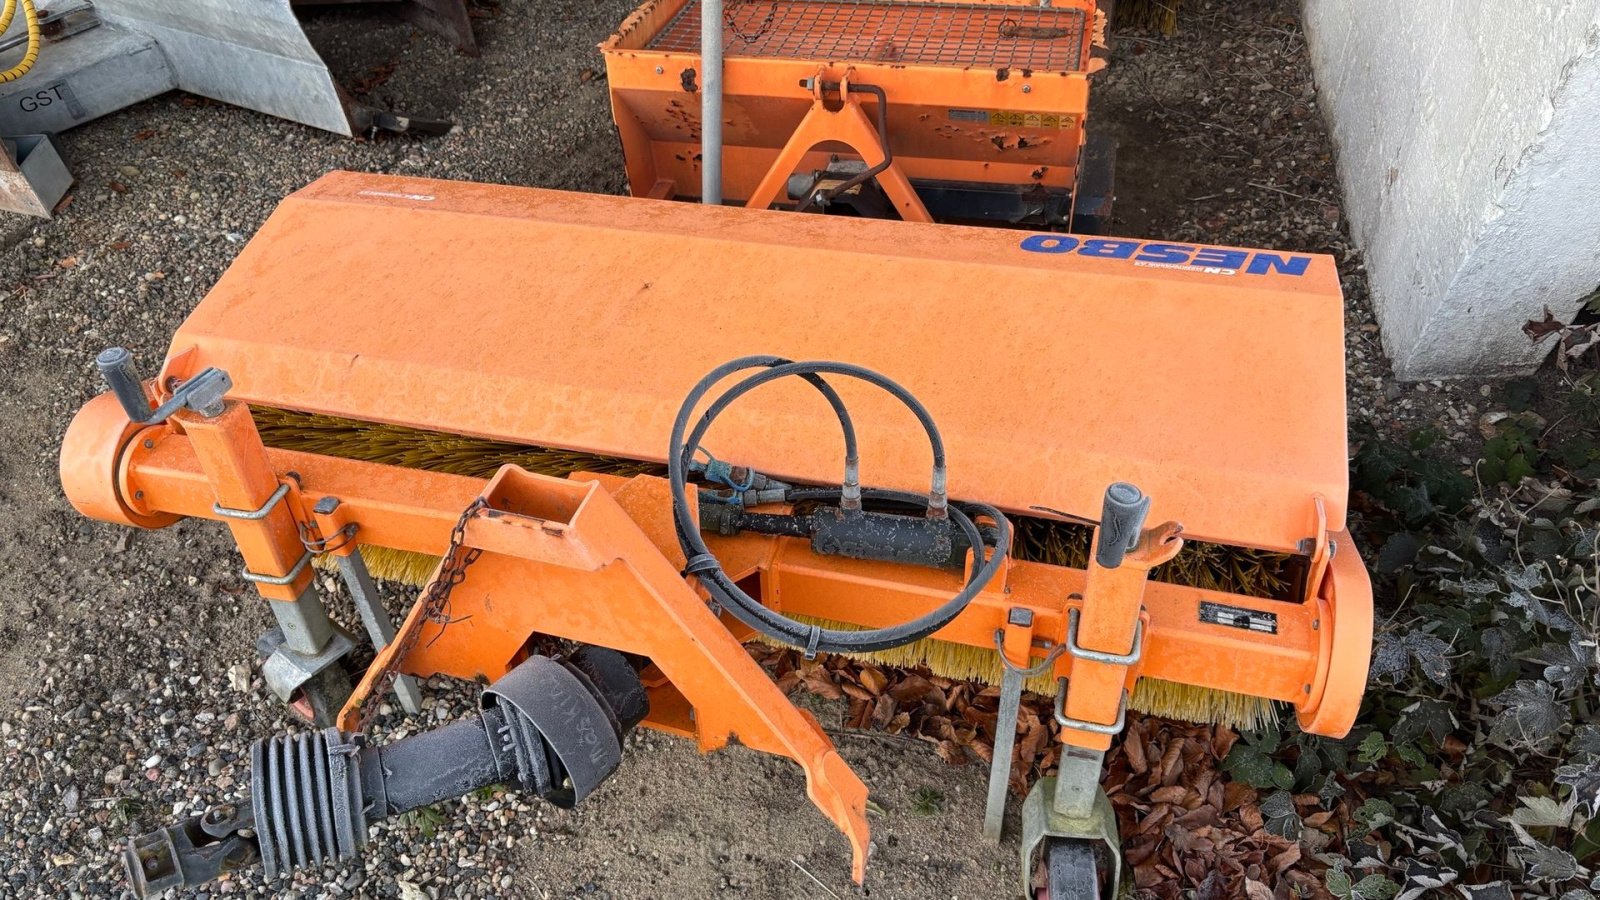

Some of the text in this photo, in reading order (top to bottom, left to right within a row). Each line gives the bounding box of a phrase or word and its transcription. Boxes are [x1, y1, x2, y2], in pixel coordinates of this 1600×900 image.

[20, 84, 63, 112] GST
[1019, 234, 1312, 276] NESBO
[1204, 267, 1236, 275] CN
